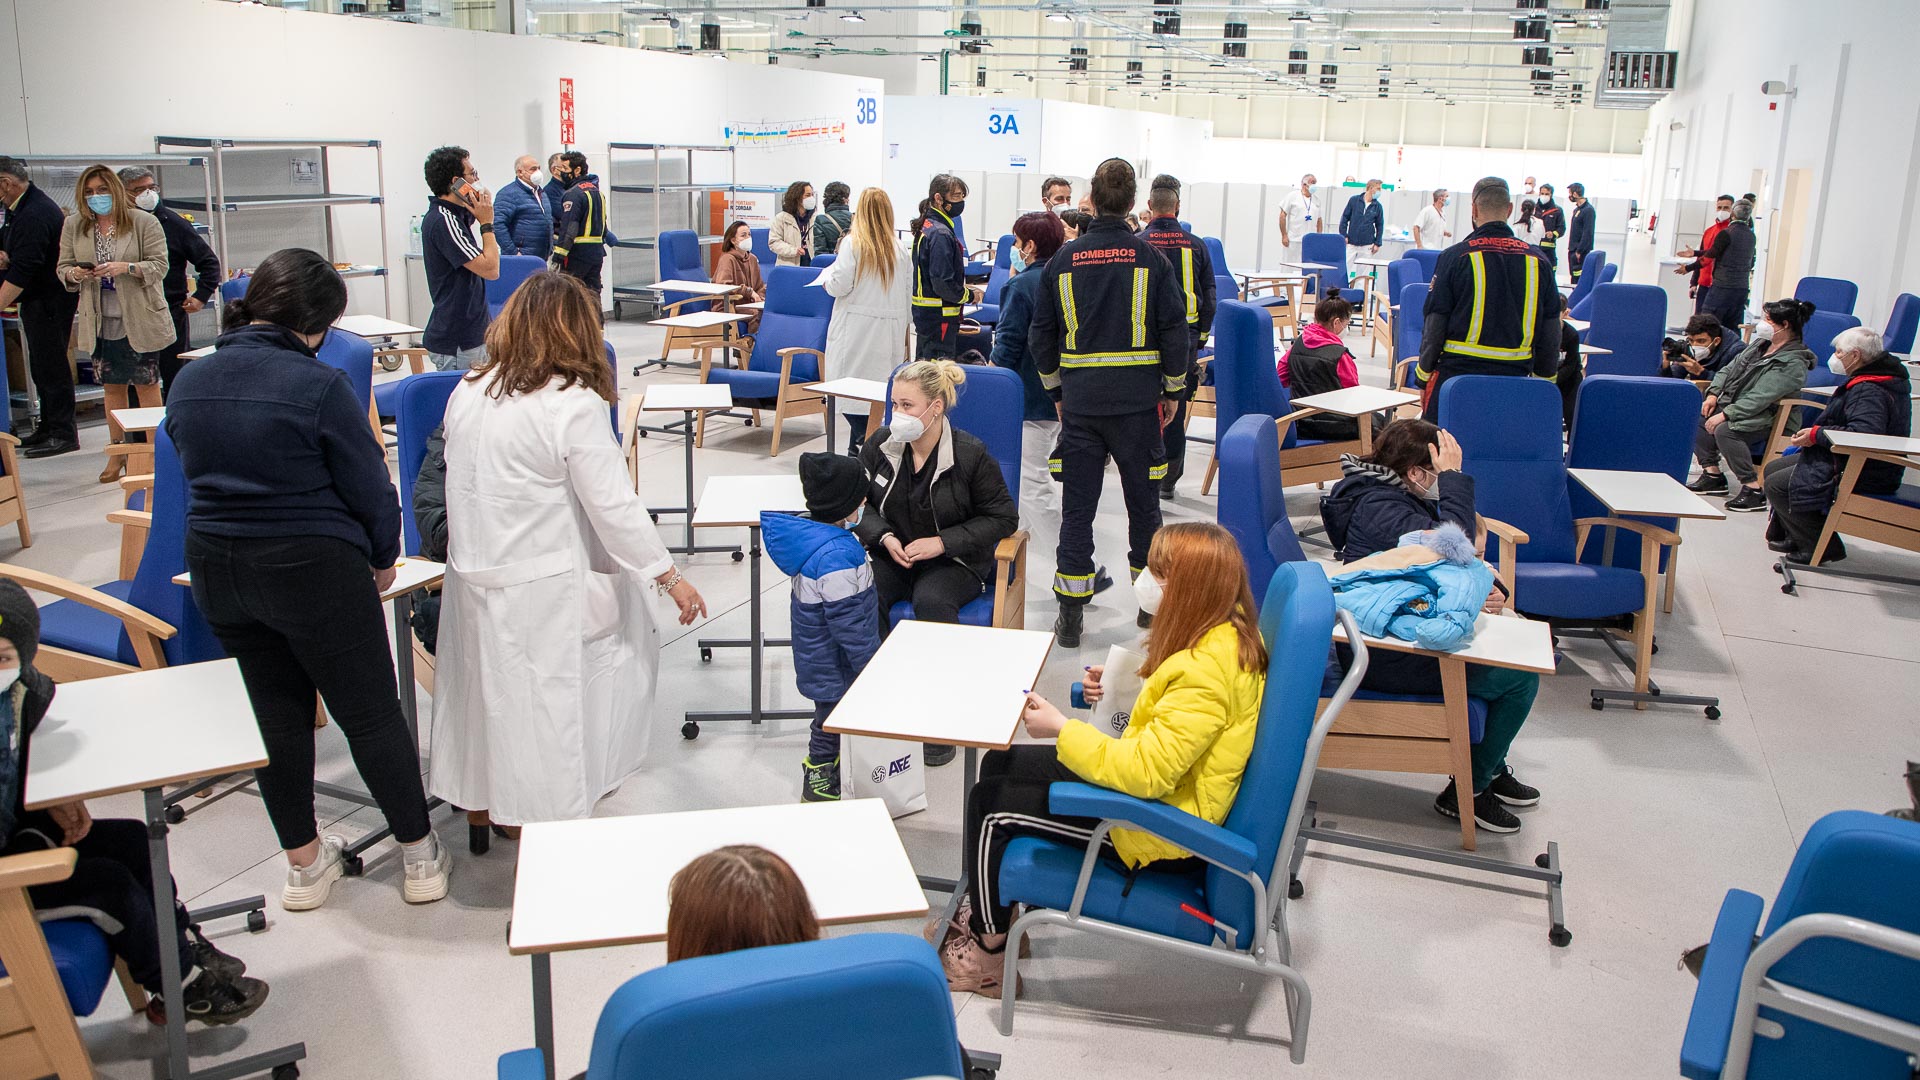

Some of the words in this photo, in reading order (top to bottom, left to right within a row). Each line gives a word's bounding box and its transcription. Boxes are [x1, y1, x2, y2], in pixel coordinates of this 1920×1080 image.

[857, 98, 877, 124] 3B
[989, 114, 1019, 134] 3A
[1468, 238, 1529, 249] BOMBEROS
[1072, 248, 1136, 261] BOMBEROS
[1072, 259, 1105, 267] Comunidad
[888, 754, 911, 776] AFE
